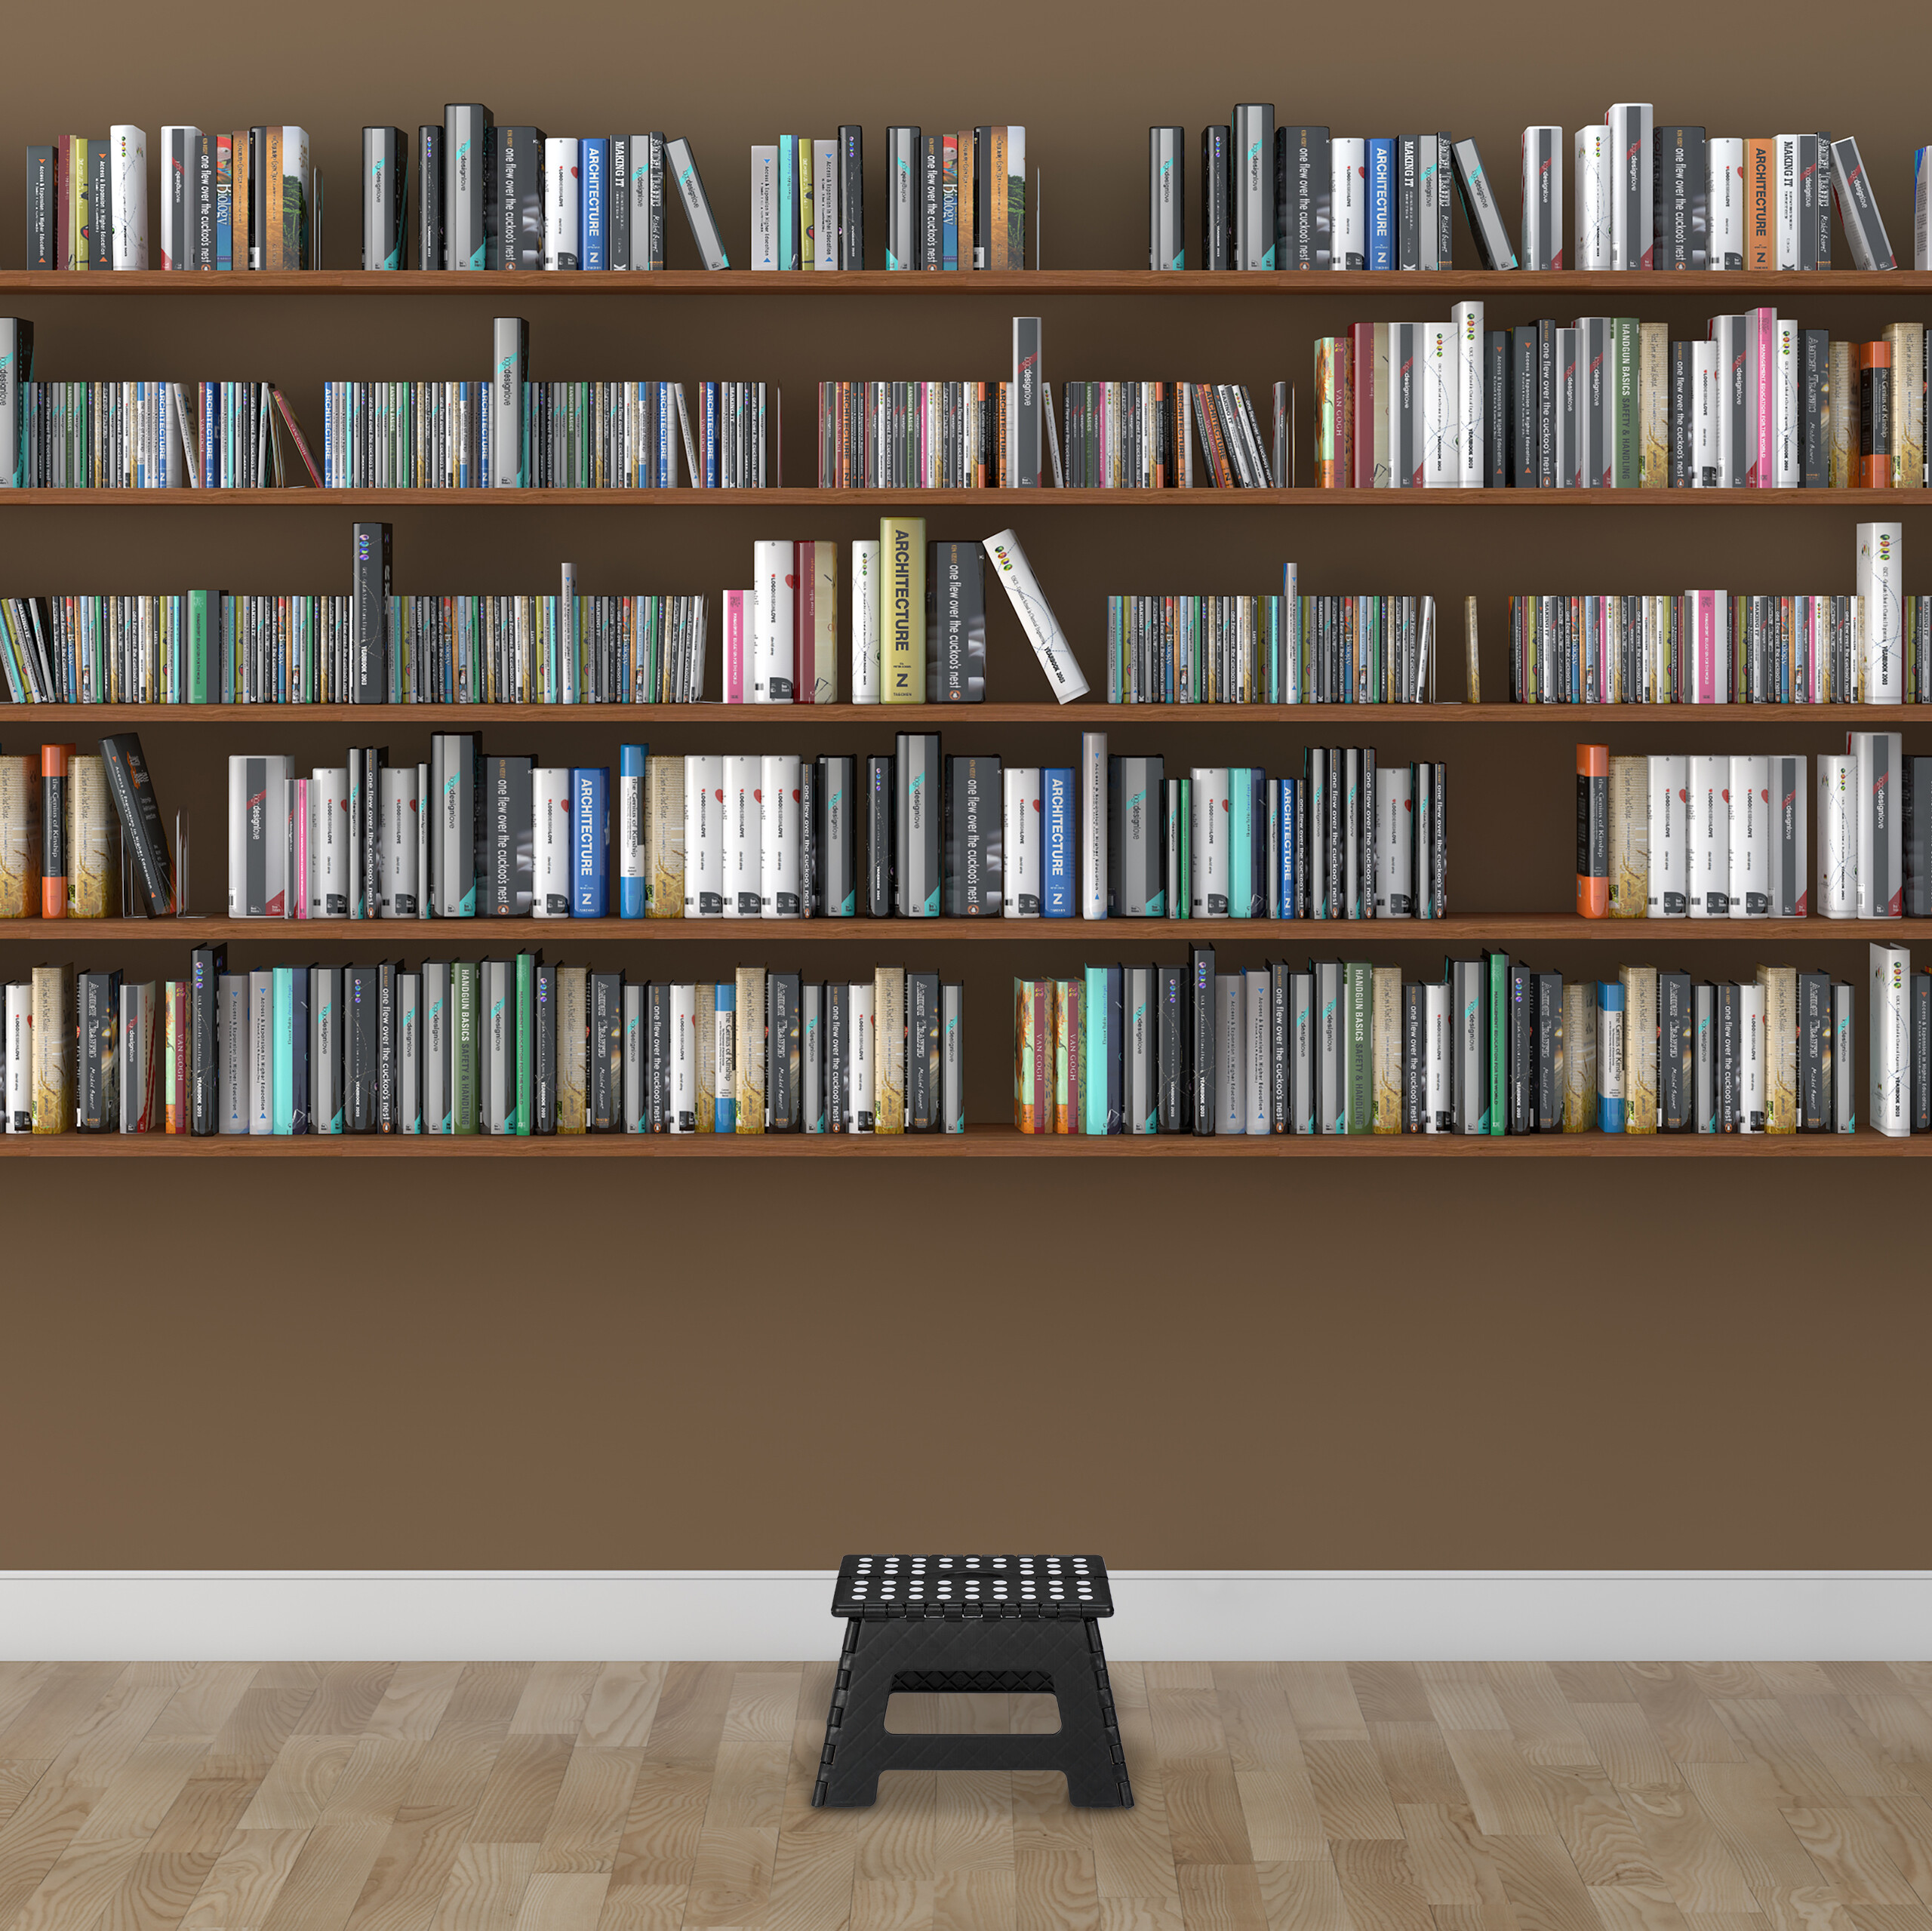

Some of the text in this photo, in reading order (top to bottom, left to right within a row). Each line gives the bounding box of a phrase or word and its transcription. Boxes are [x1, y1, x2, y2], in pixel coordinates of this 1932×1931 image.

[506, 148, 514, 161] one
[615, 141, 625, 176] MAKING
[1675, 148, 1684, 161] one
[1784, 141, 1793, 176] MAKING
[506, 164, 517, 179] flew
[616, 178, 625, 187] IT
[1675, 164, 1687, 179] flew
[1784, 178, 1793, 186] IT
[506, 180, 514, 196] over
[589, 148, 598, 236] ARCHITECTURE
[1377, 148, 1386, 236] ARCHITECTURE
[1675, 180, 1684, 196] over
[1756, 148, 1766, 236] ARCHITECTURE
[217, 184, 232, 224] Biology
[506, 198, 517, 210] the
[1675, 198, 1687, 210] the
[506, 212, 517, 243] cuckoo's
[1675, 212, 1687, 243] cuckoo's
[506, 245, 516, 260] nest
[1675, 245, 1687, 260] nest
[1543, 361, 1552, 378] flew
[1677, 377, 1685, 392] flew
[1543, 418, 1552, 454] cuckoo's
[896, 530, 909, 651] ARCHITECTURE
[949, 565, 962, 688] one flew over the cuckoo's nest
[581, 779, 592, 876] ARCHITECTURE
[1052, 779, 1063, 876] ARCHITECTURE
[968, 779, 980, 902] one flew over the cuckoo's nest
